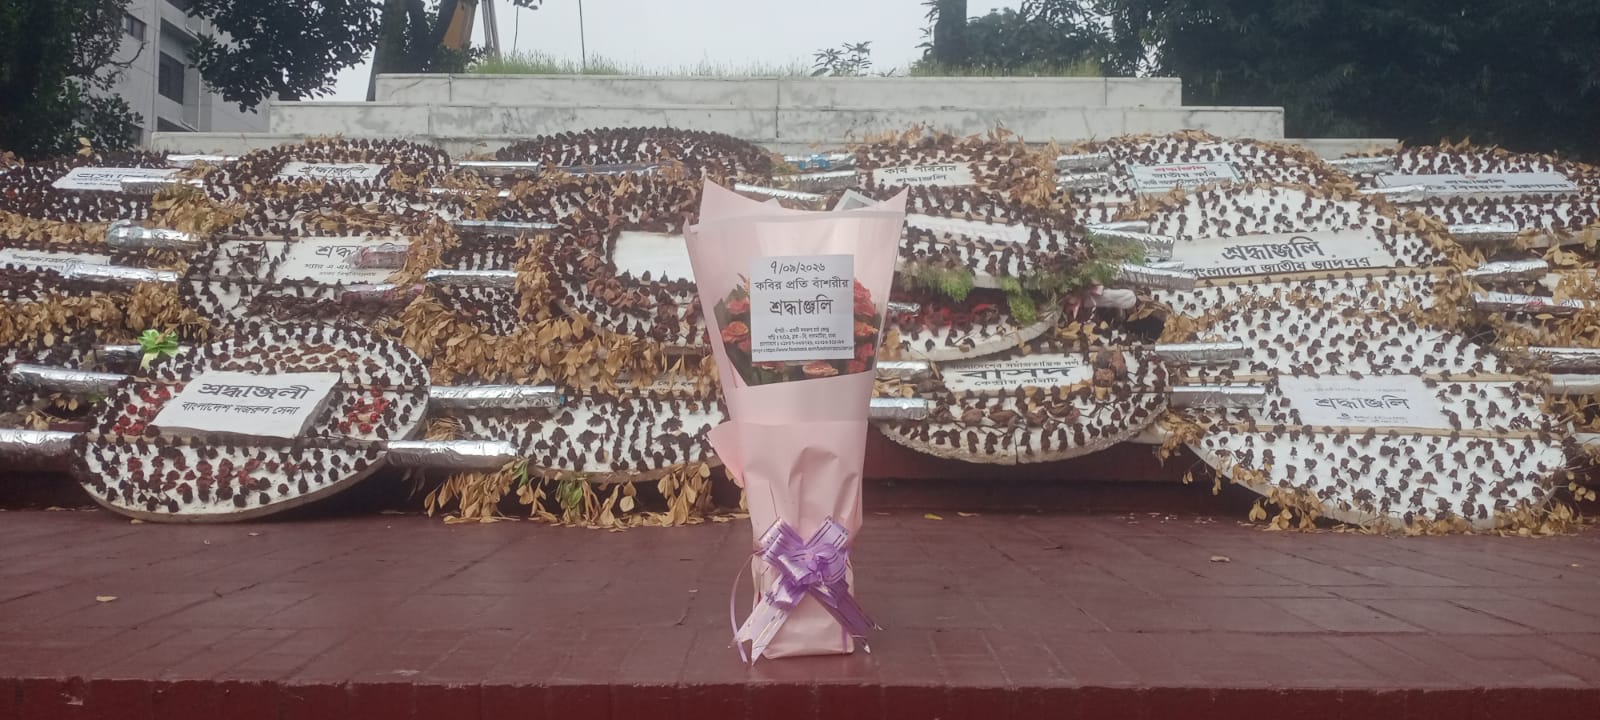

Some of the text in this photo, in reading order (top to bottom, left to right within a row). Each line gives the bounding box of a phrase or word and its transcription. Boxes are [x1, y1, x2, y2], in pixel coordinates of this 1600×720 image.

[1222, 236, 1325, 261] শ্রদ্ধাঞ্জলি
[1311, 256, 1371, 269] জাদঘর
[753, 276, 849, 291] কবির প্রতি বাঁশরীর
[769, 294, 834, 316] শ্রদ্ধাঞ্জলি
[198, 383, 315, 400] শ্রদ্ধাঞ্জলী
[181, 401, 301, 416] বাংলাদেশ নজরুল সেনা
[1313, 394, 1411, 410] শ্রদ্ধাঞ্জলি
